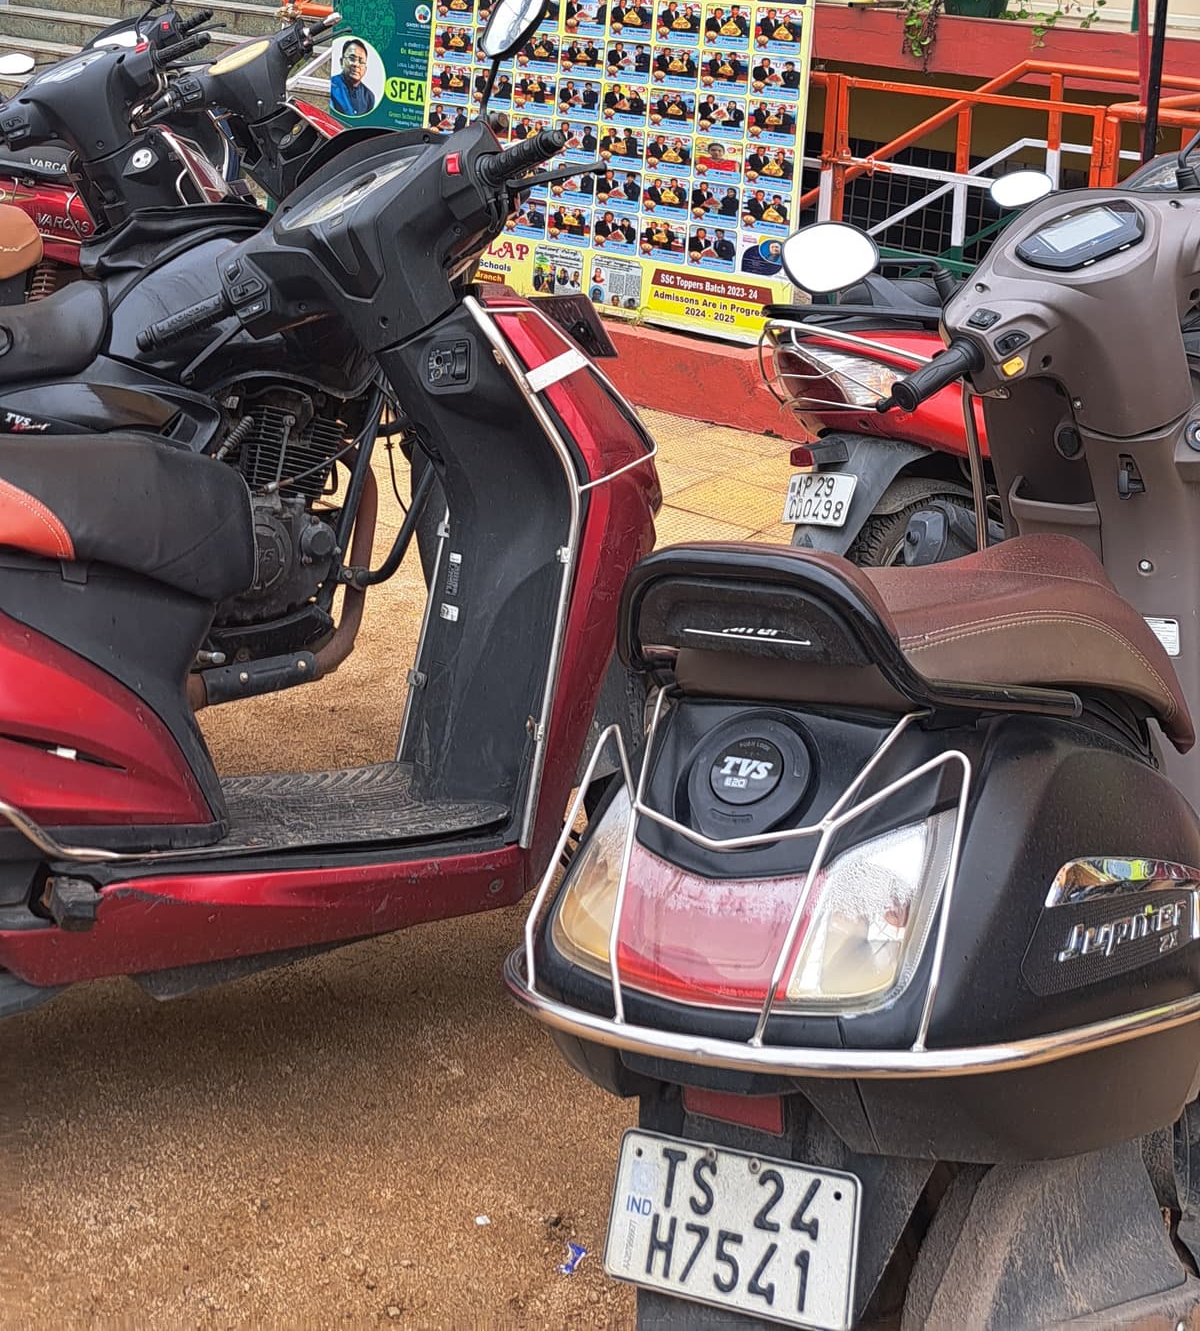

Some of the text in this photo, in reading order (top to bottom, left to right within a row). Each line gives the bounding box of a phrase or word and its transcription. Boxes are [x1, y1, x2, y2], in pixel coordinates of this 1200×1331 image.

[390, 79, 424, 103] SPEA
[480, 258, 511, 272] Schools
[660, 273, 758, 300] SSC Toppers Batch 2023- 24
[653, 290, 728, 311] Admissons Are in
[685, 307, 735, 324] 2024 2025
[5, 412, 32, 426] TVS
[796, 476, 835, 498] AP 29
[720, 756, 774, 780] TVS
[1054, 900, 1187, 962] Jupiter
[1159, 930, 1179, 953] ZX
[626, 1195, 652, 1216] IND
[662, 1147, 822, 1241] TS 24
[645, 1213, 811, 1313] H7541
